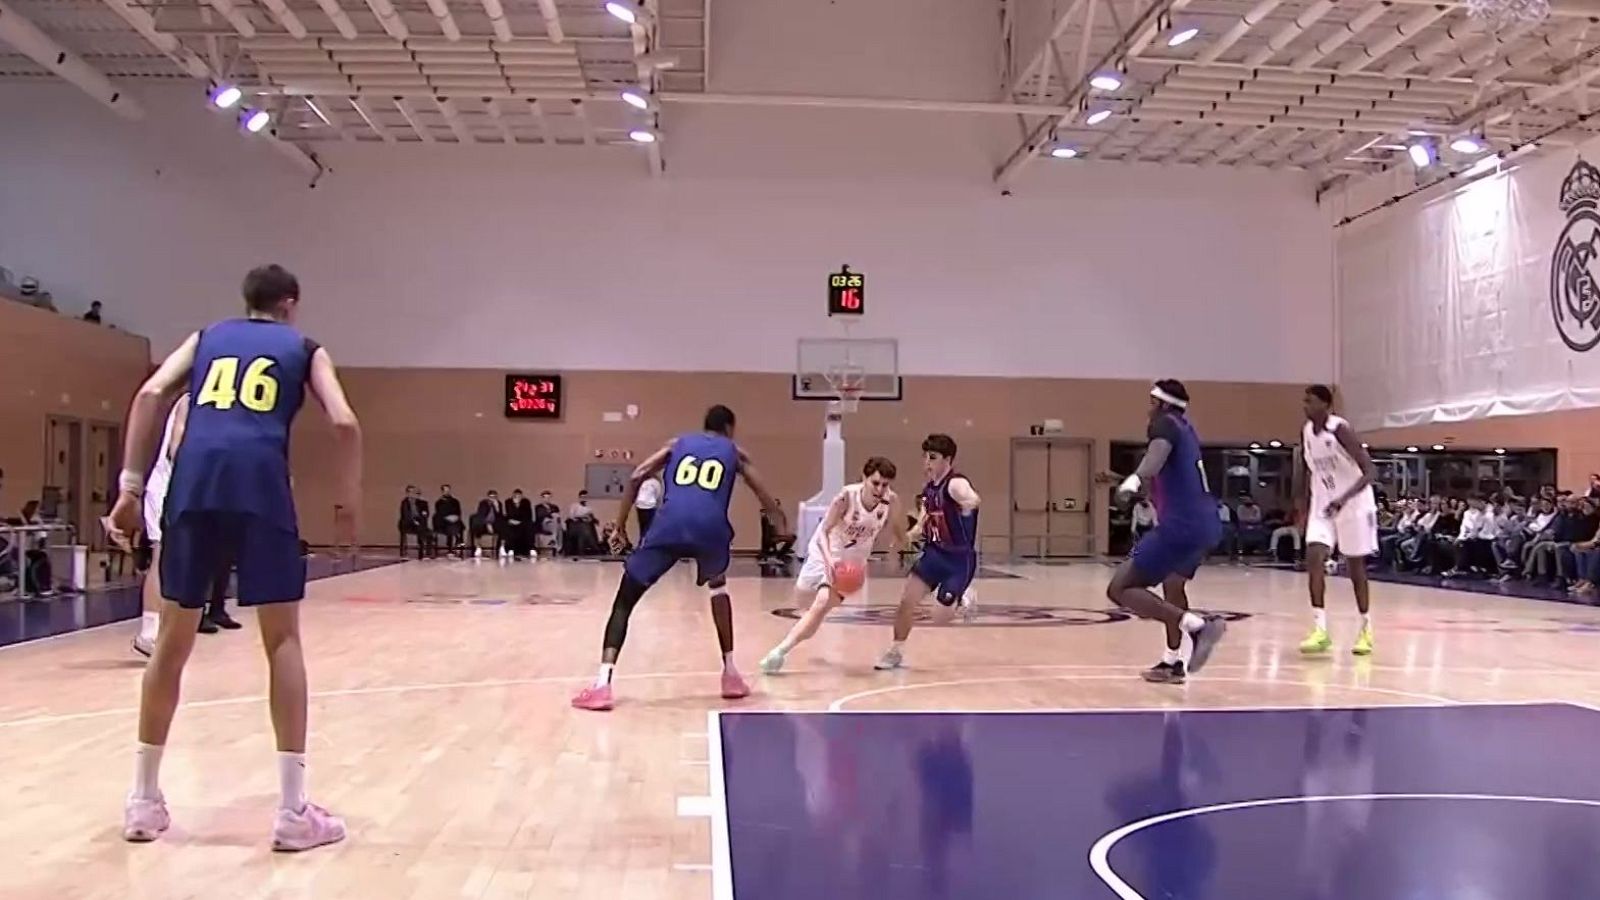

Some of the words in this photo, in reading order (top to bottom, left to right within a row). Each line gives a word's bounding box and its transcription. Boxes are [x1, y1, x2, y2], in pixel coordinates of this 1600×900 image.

[841, 289, 860, 309] 16
[196, 356, 280, 412] 46
[674, 454, 724, 491] 60
